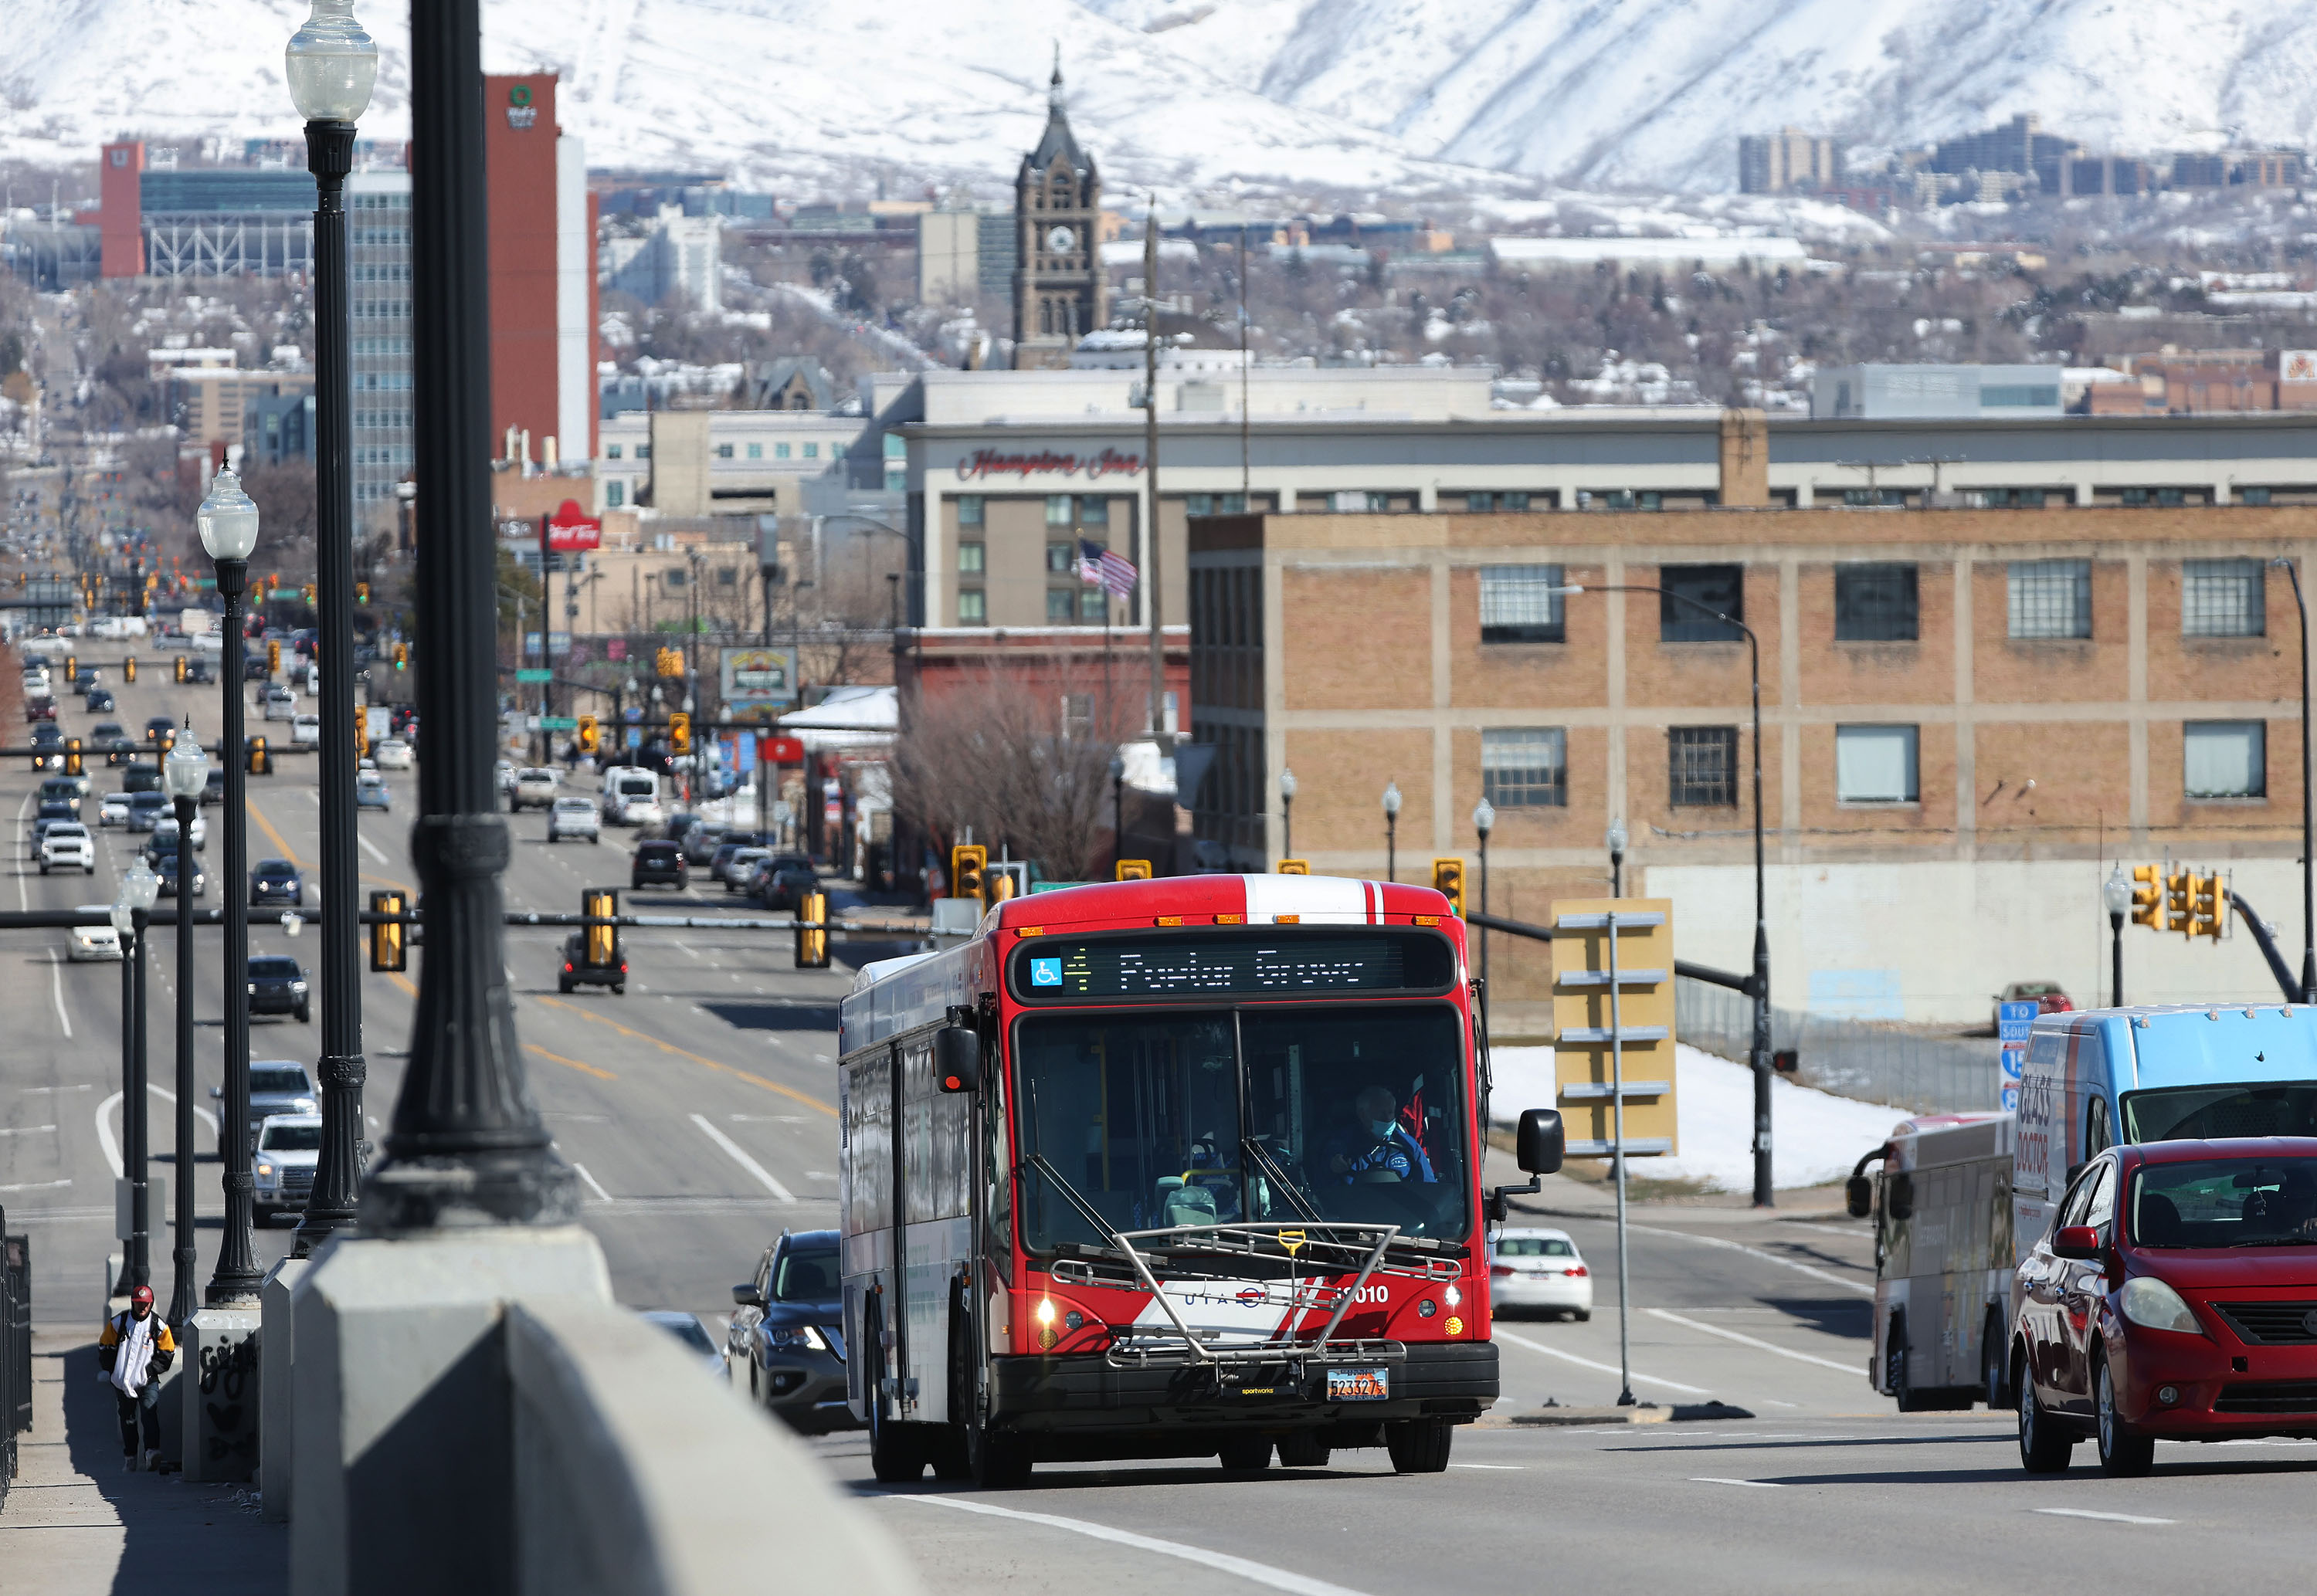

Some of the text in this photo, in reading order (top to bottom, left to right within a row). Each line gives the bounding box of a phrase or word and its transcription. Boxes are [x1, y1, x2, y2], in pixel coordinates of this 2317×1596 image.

[957, 446, 1148, 481] Hampton Inn
[2010, 1005, 2029, 1019] TO
[2006, 1091, 2018, 1111] 8
[2020, 1073, 2051, 1127] GLASS
[2017, 1131, 2049, 1183] DOCTOR
[1331, 1380, 1376, 1395] 523327
